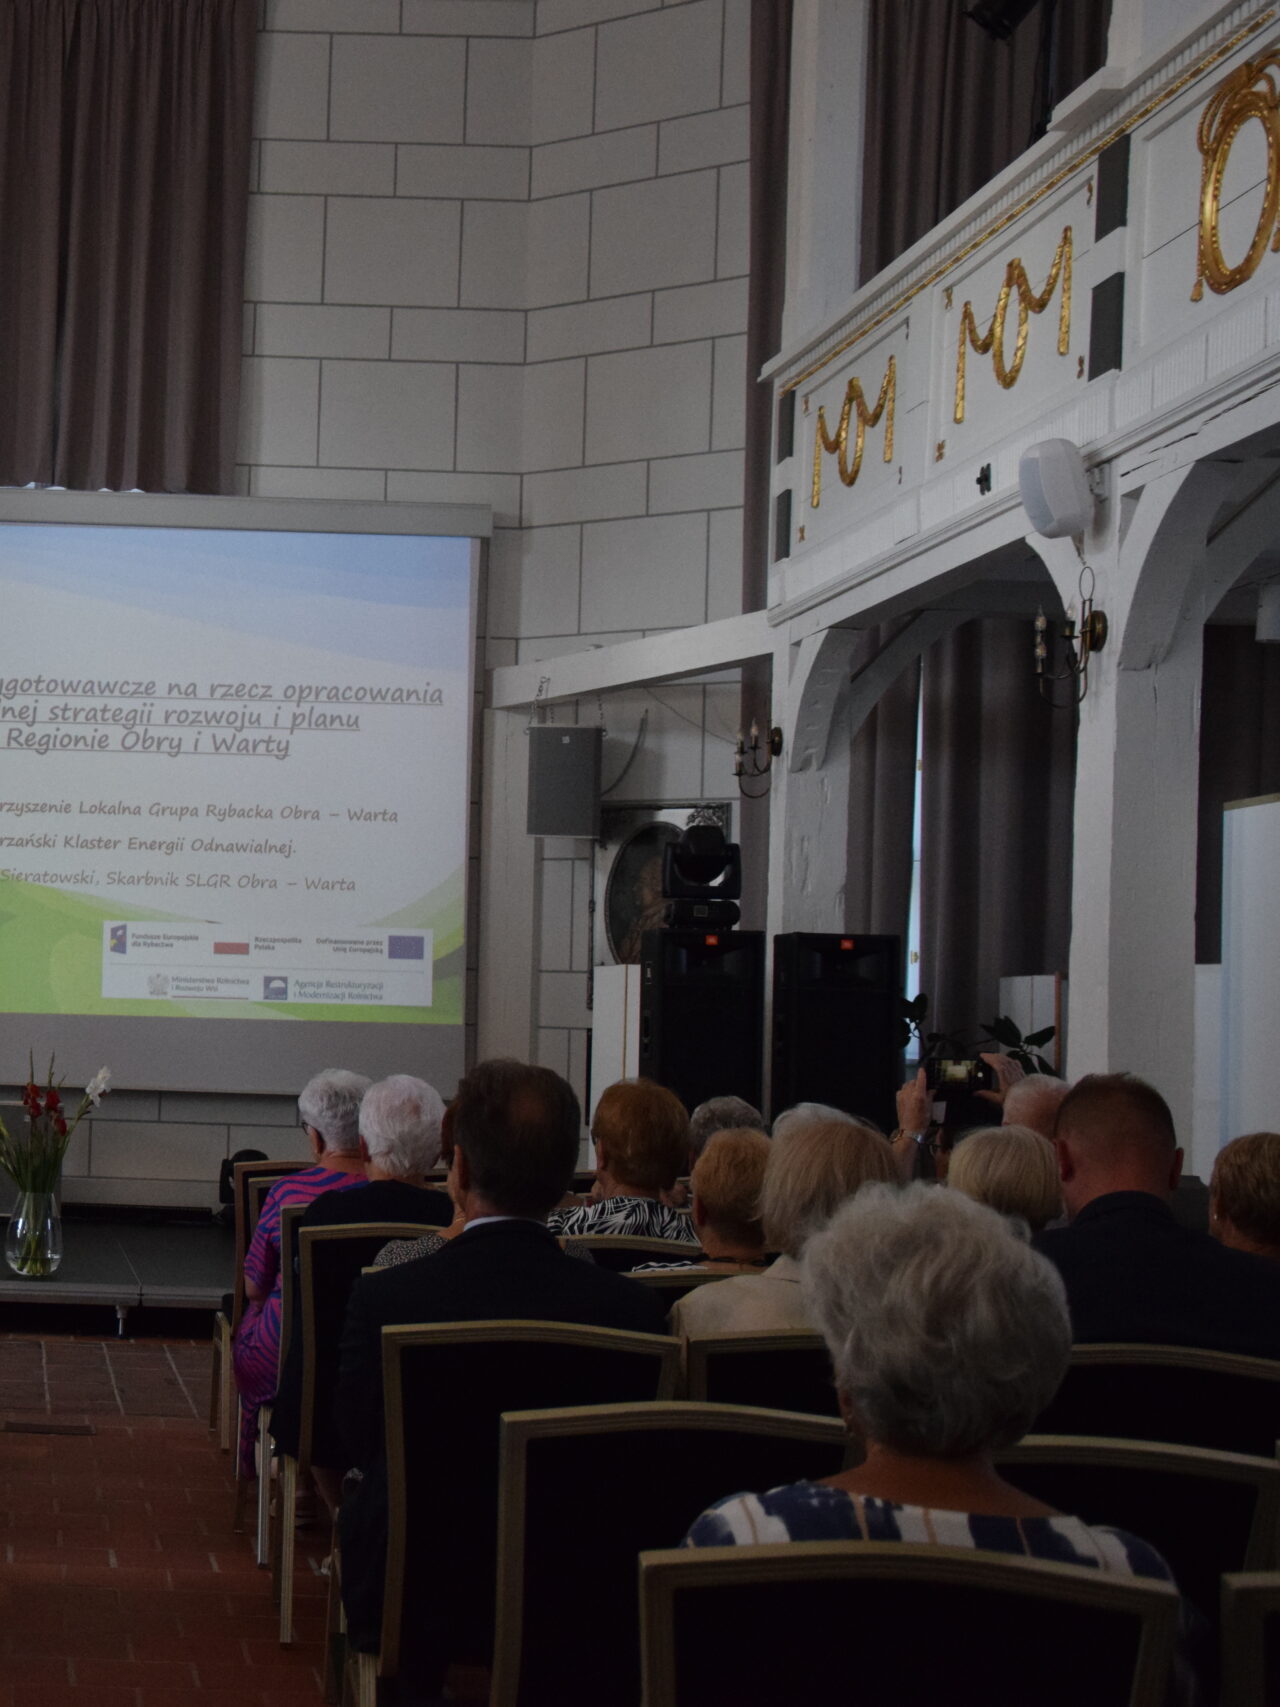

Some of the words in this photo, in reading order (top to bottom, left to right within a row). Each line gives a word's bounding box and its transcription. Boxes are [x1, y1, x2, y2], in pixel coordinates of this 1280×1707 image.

[167, 682, 198, 698] na
[209, 683, 273, 700] rzecz
[283, 682, 444, 708] opracowania
[48, 702, 154, 730] strategii
[163, 705, 261, 732] rozwoju
[273, 706, 282, 727] i
[289, 706, 360, 735] planu
[6, 728, 110, 755] Regionie
[120, 728, 183, 758] Obry
[193, 730, 203, 752] i
[211, 733, 291, 760] Warty
[78, 801, 142, 816] Lokalna
[148, 802, 199, 822] Grupa
[205, 804, 274, 822] Rybacka
[280, 806, 321, 821] Obra
[347, 808, 399, 823] Warta
[63, 834, 121, 850] Klaster
[128, 837, 185, 856] Energii
[191, 838, 297, 859] Odnawialnej.
[106, 870, 180, 886] Skarbnik
[185, 873, 231, 888] SLGR
[237, 873, 278, 889] Obra
[305, 876, 356, 892] Warta
